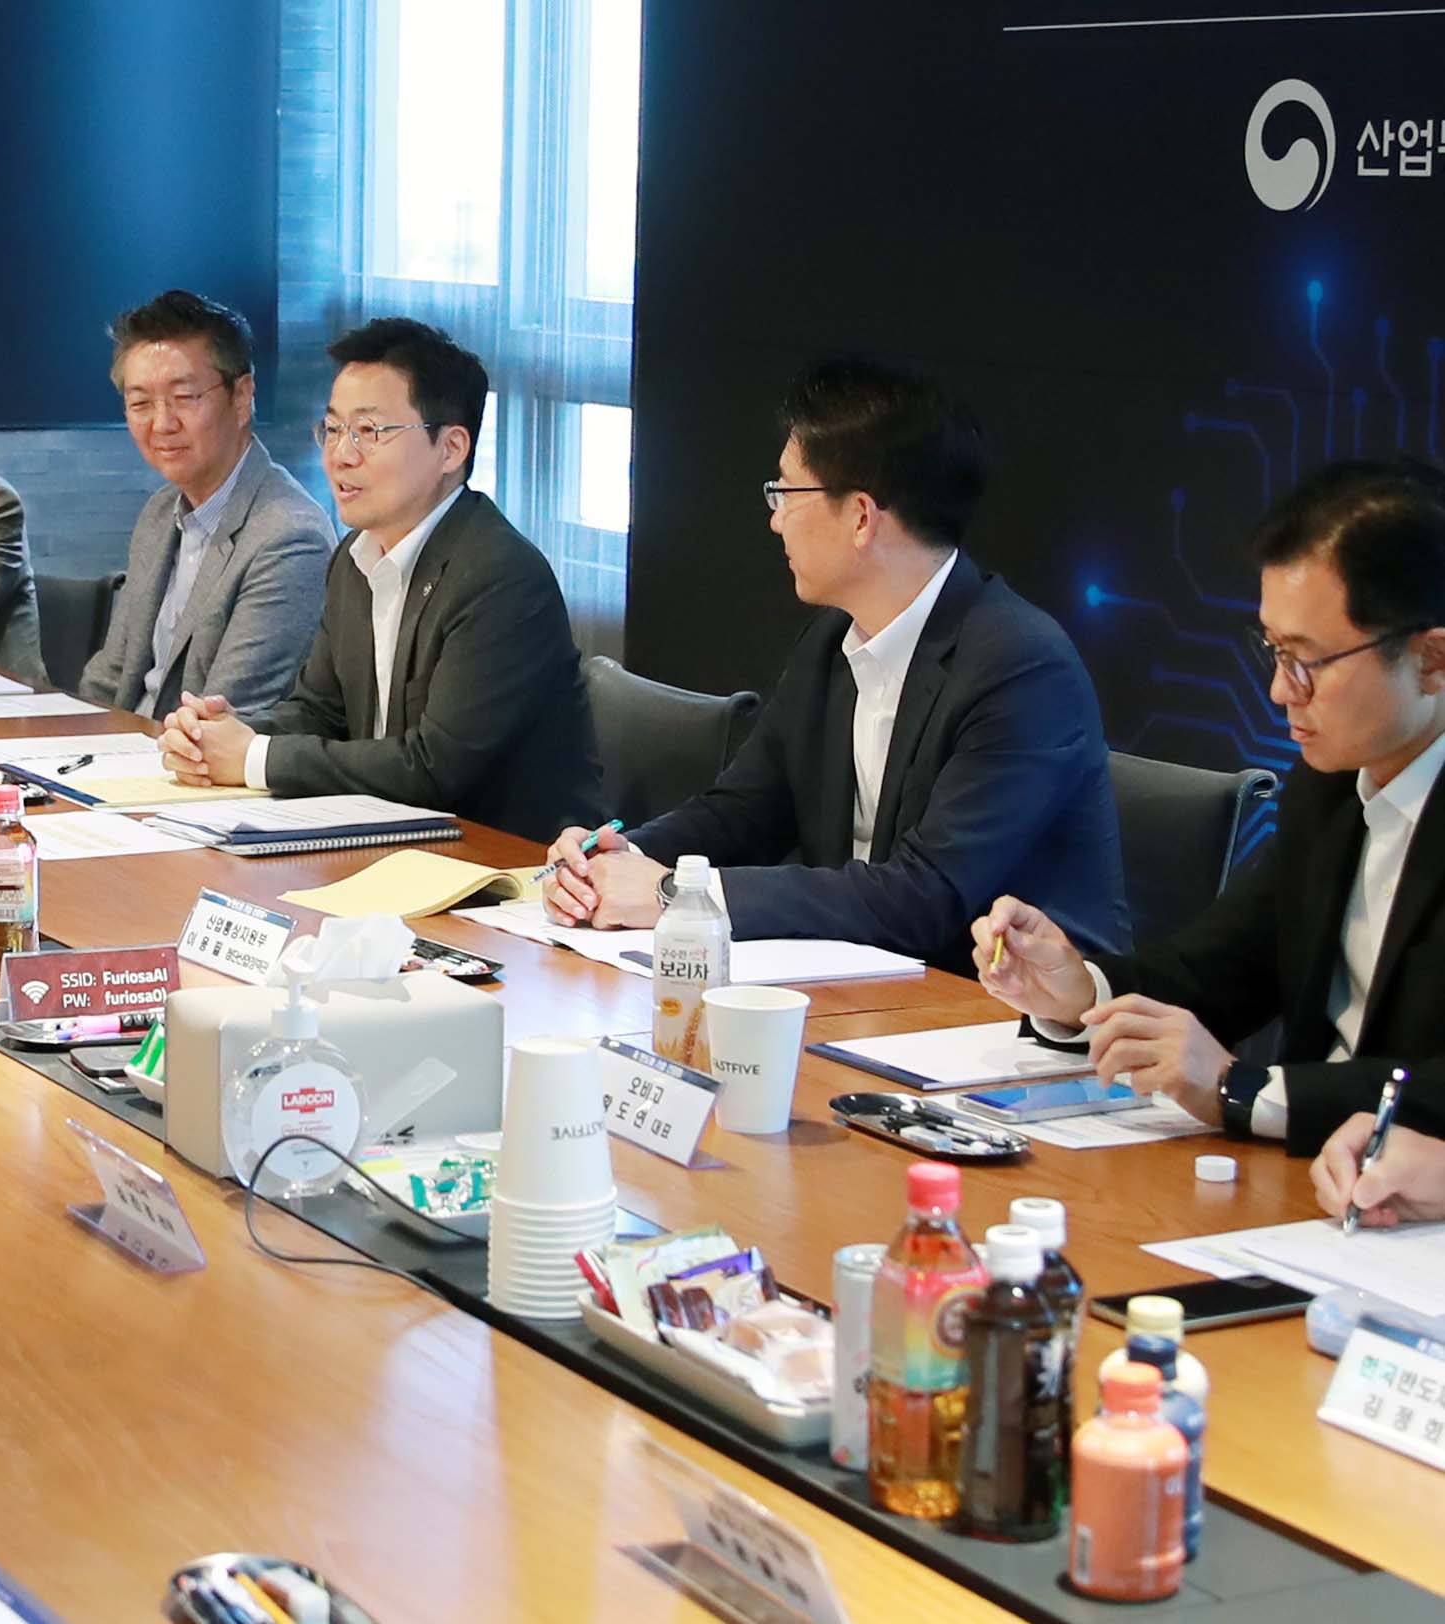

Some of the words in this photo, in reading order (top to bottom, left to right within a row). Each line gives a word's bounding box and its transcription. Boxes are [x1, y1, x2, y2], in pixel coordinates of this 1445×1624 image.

[206, 913, 268, 947] 산업통상자원부
[60, 971, 97, 989] SSID:
[102, 966, 168, 986] FuriosaAI
[660, 960, 710, 981] 보리차
[62, 991, 92, 1009] PW:
[713, 1057, 762, 1076] ASTFIVE
[628, 1076, 665, 1105] 오비고
[550, 1121, 604, 1141] ASTFIVE
[651, 1117, 673, 1140] 대표
